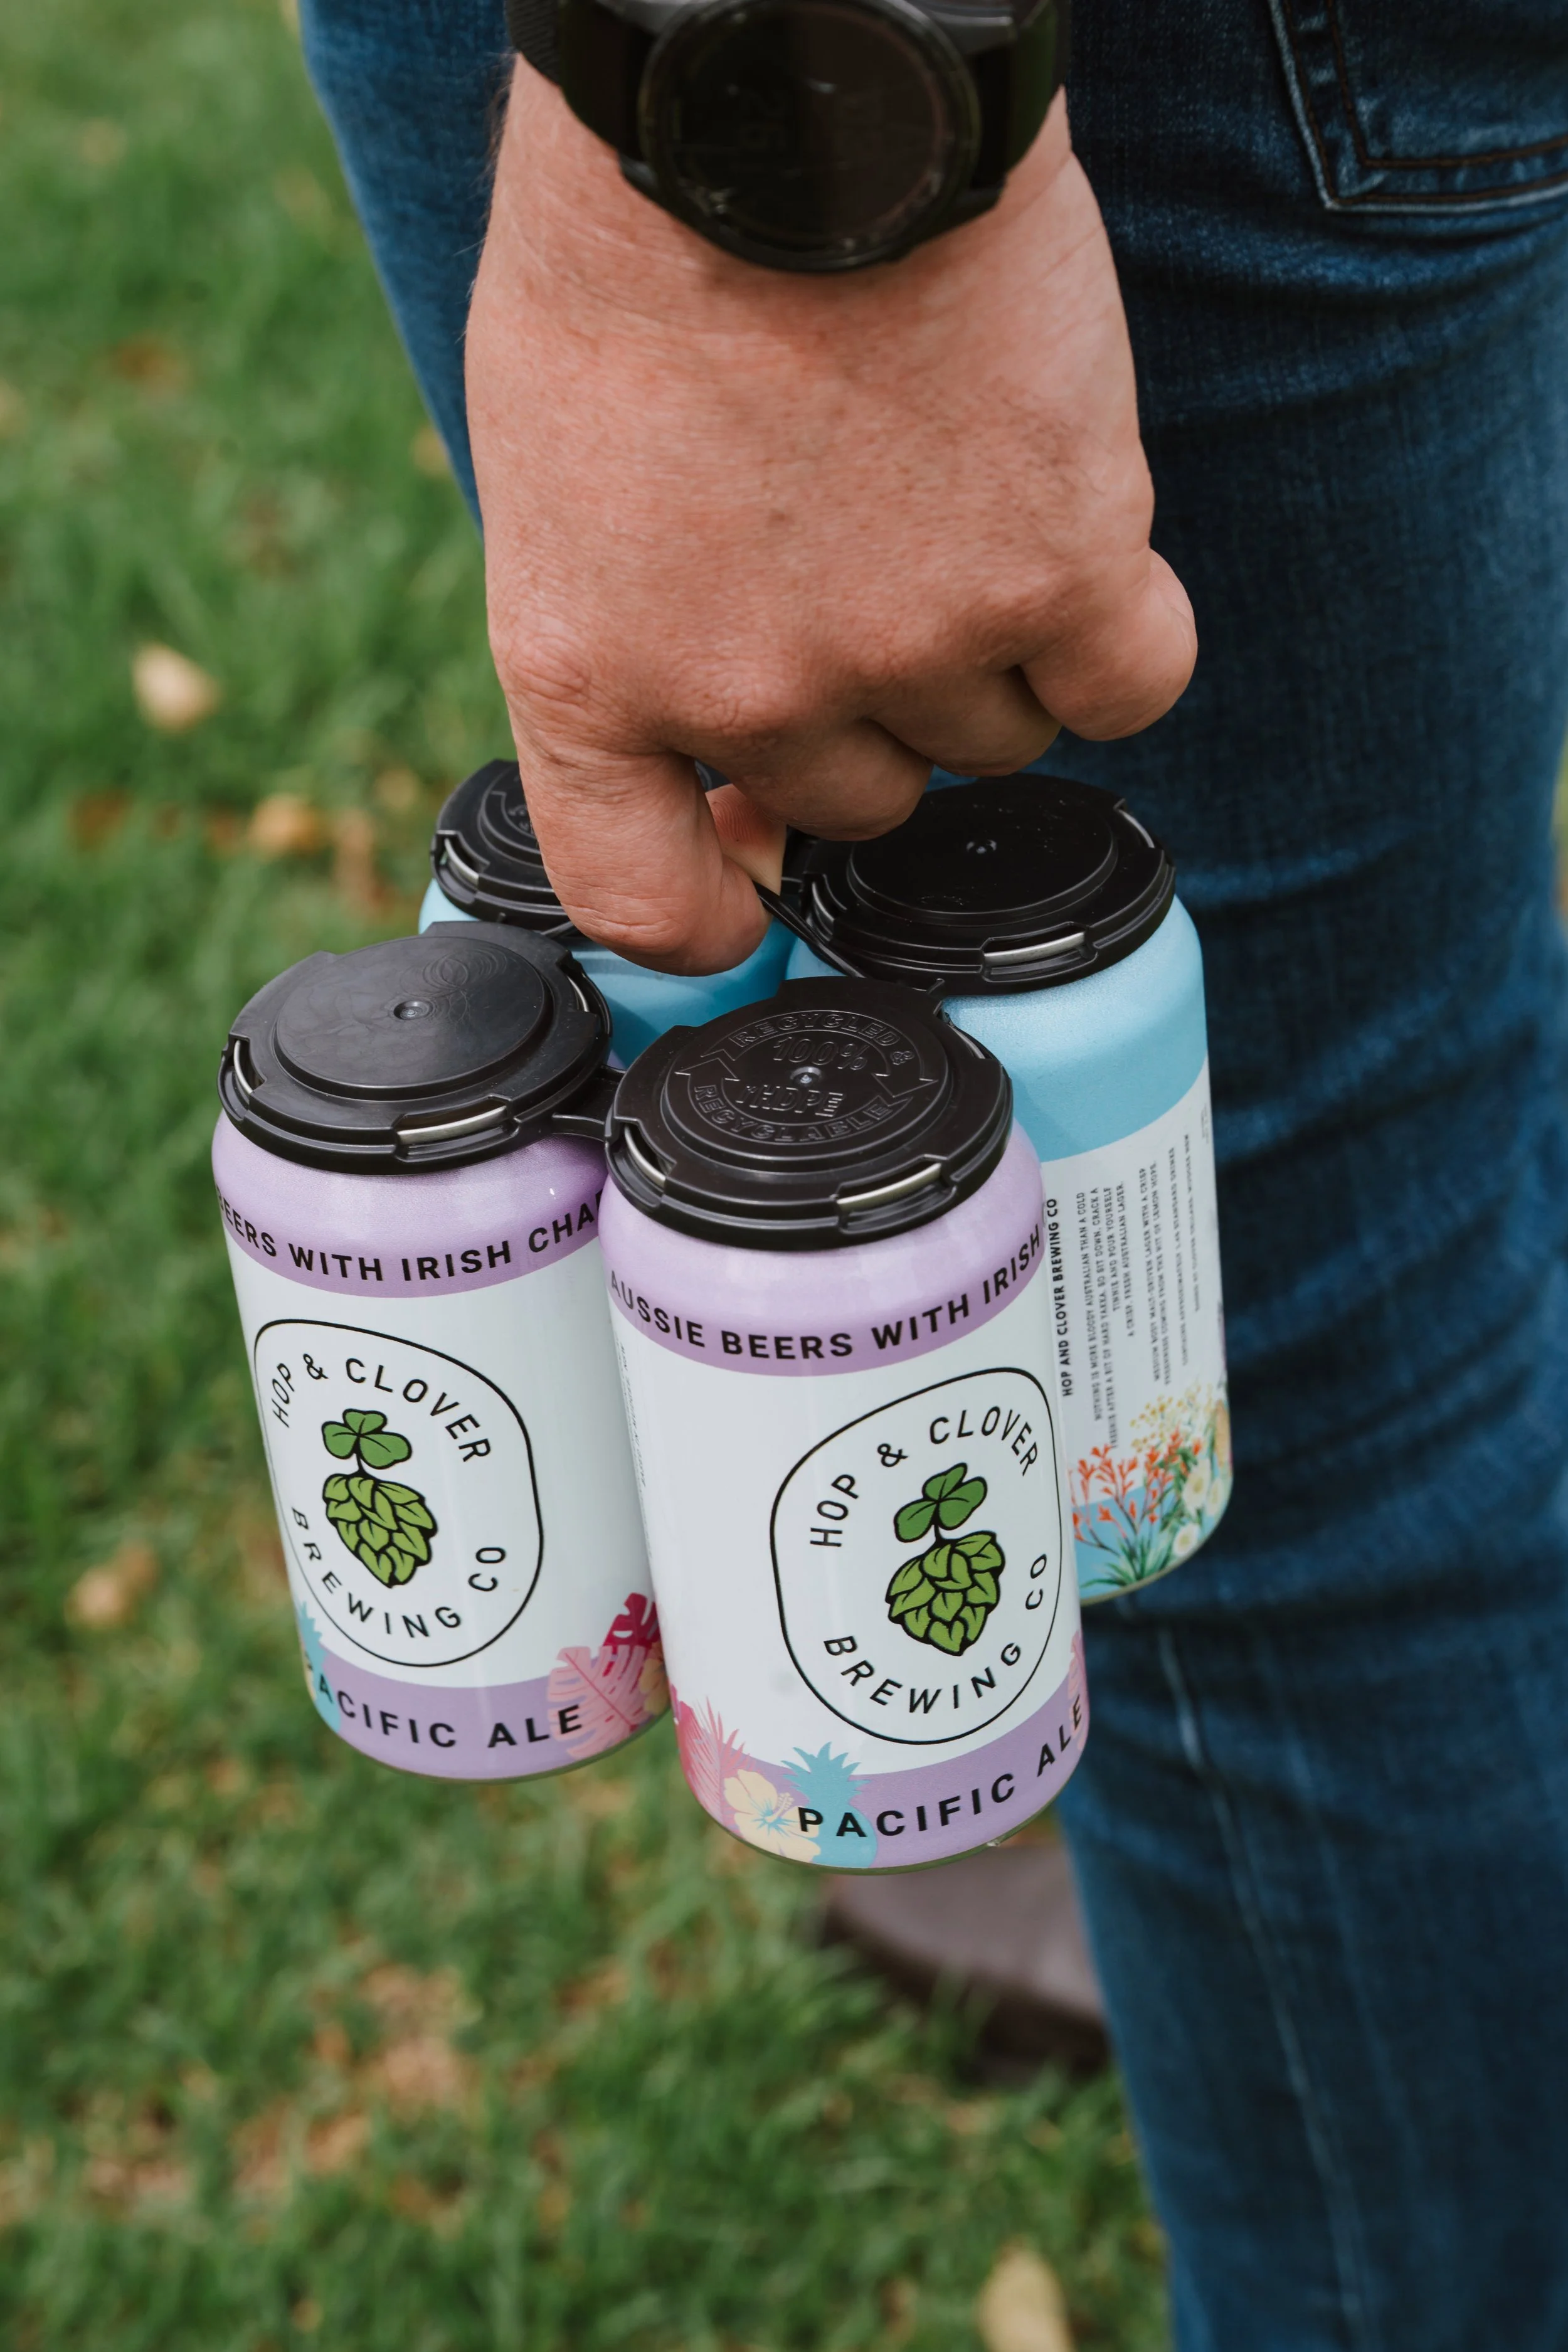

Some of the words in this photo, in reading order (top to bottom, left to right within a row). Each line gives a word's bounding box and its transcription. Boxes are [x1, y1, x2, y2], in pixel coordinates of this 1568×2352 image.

[729, 1015, 901, 1047] RECYCLED
[772, 1036, 869, 1071] 100%
[694, 1084, 894, 1143] RECYCLABLE
[1047, 1198, 1057, 1217] CO
[1076, 1192, 1086, 1215] COLD
[1090, 1196, 1101, 1226] CRACK
[1103, 1187, 1115, 1231] YOURSELF
[1049, 1221, 1062, 1281] BREWING
[1078, 1226, 1089, 1251] THAN
[1106, 1232, 1116, 1256] POUR
[1118, 1215, 1130, 1268] AUSTRALIAN
[288, 1242, 383, 1282] WITH
[401, 1240, 512, 1282] IRISH
[1080, 1253, 1094, 1306] AUSTRALIAN
[1108, 1259, 1118, 1278] AND
[610, 1269, 706, 1348] AUSSIE
[721, 1330, 854, 1360] BEERS
[871, 1293, 970, 1350] WITH
[982, 1224, 1040, 1305] IRISH
[1054, 1286, 1067, 1335] CLOVER
[1059, 1340, 1069, 1366] AND
[1062, 1370, 1072, 1396] HOP
[271, 1364, 295, 1429] HOP
[304, 1353, 329, 1380] &
[345, 1357, 492, 1463] CLOVER
[810, 1473, 861, 1548] HOP
[877, 1443, 909, 1468] &
[929, 1404, 1039, 1476] CLOVER
[292, 1507, 462, 1638] BREWING
[468, 1547, 506, 1592] CO
[824, 1634, 1022, 1714] BREWING
[1025, 1553, 1047, 1611] CO
[487, 1705, 583, 1749] ALE
[798, 1772, 1015, 1838] PACIFIC
[1037, 1693, 1083, 1777] ALE
